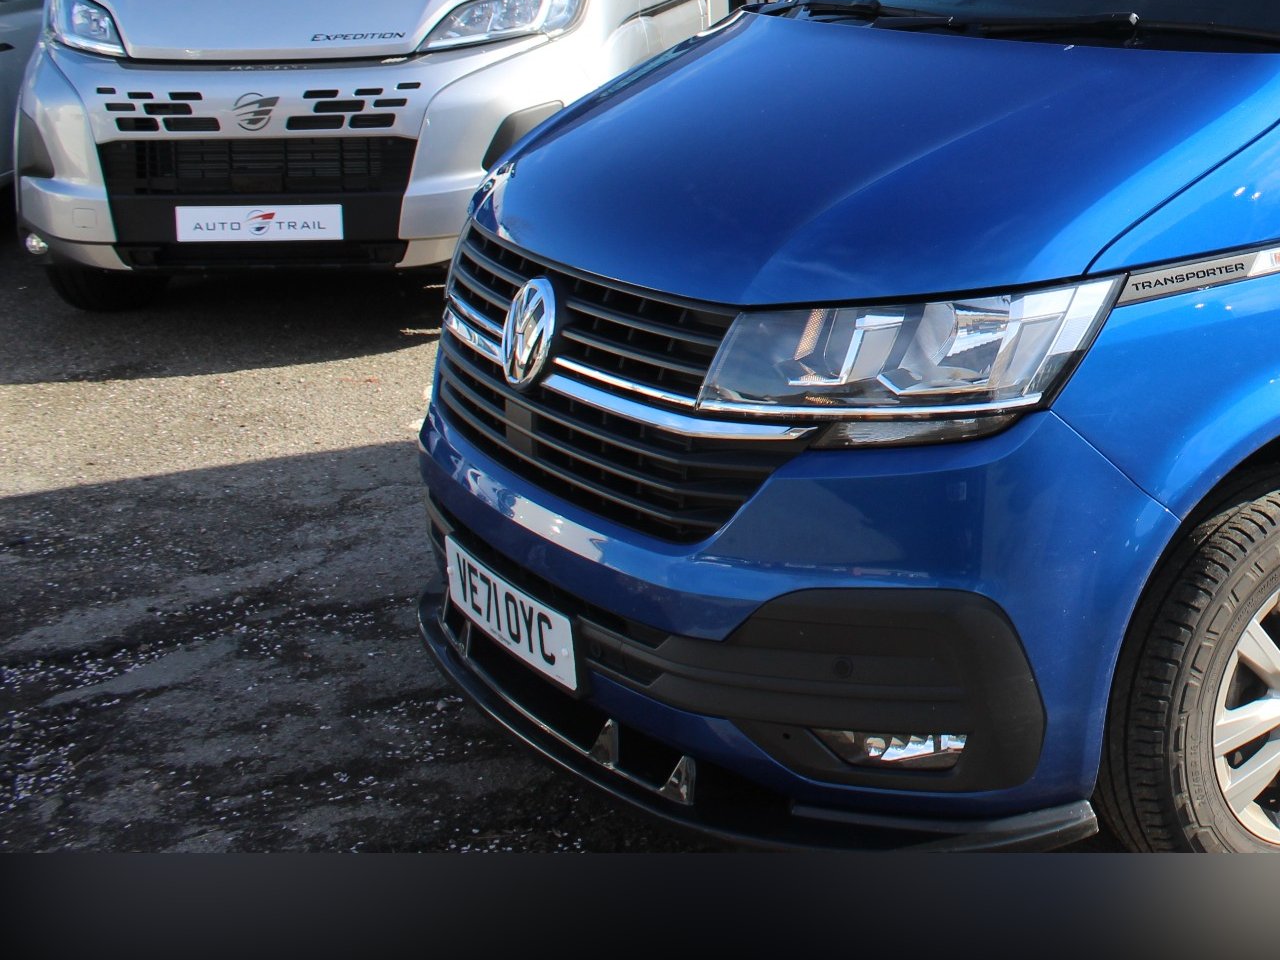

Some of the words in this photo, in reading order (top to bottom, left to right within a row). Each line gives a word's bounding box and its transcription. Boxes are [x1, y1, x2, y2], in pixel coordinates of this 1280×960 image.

[311, 32, 407, 42] EXPEDITION
[193, 222, 241, 231] AUTO
[276, 221, 327, 230] TRAIL
[1132, 262, 1245, 291] TRANSPORTER
